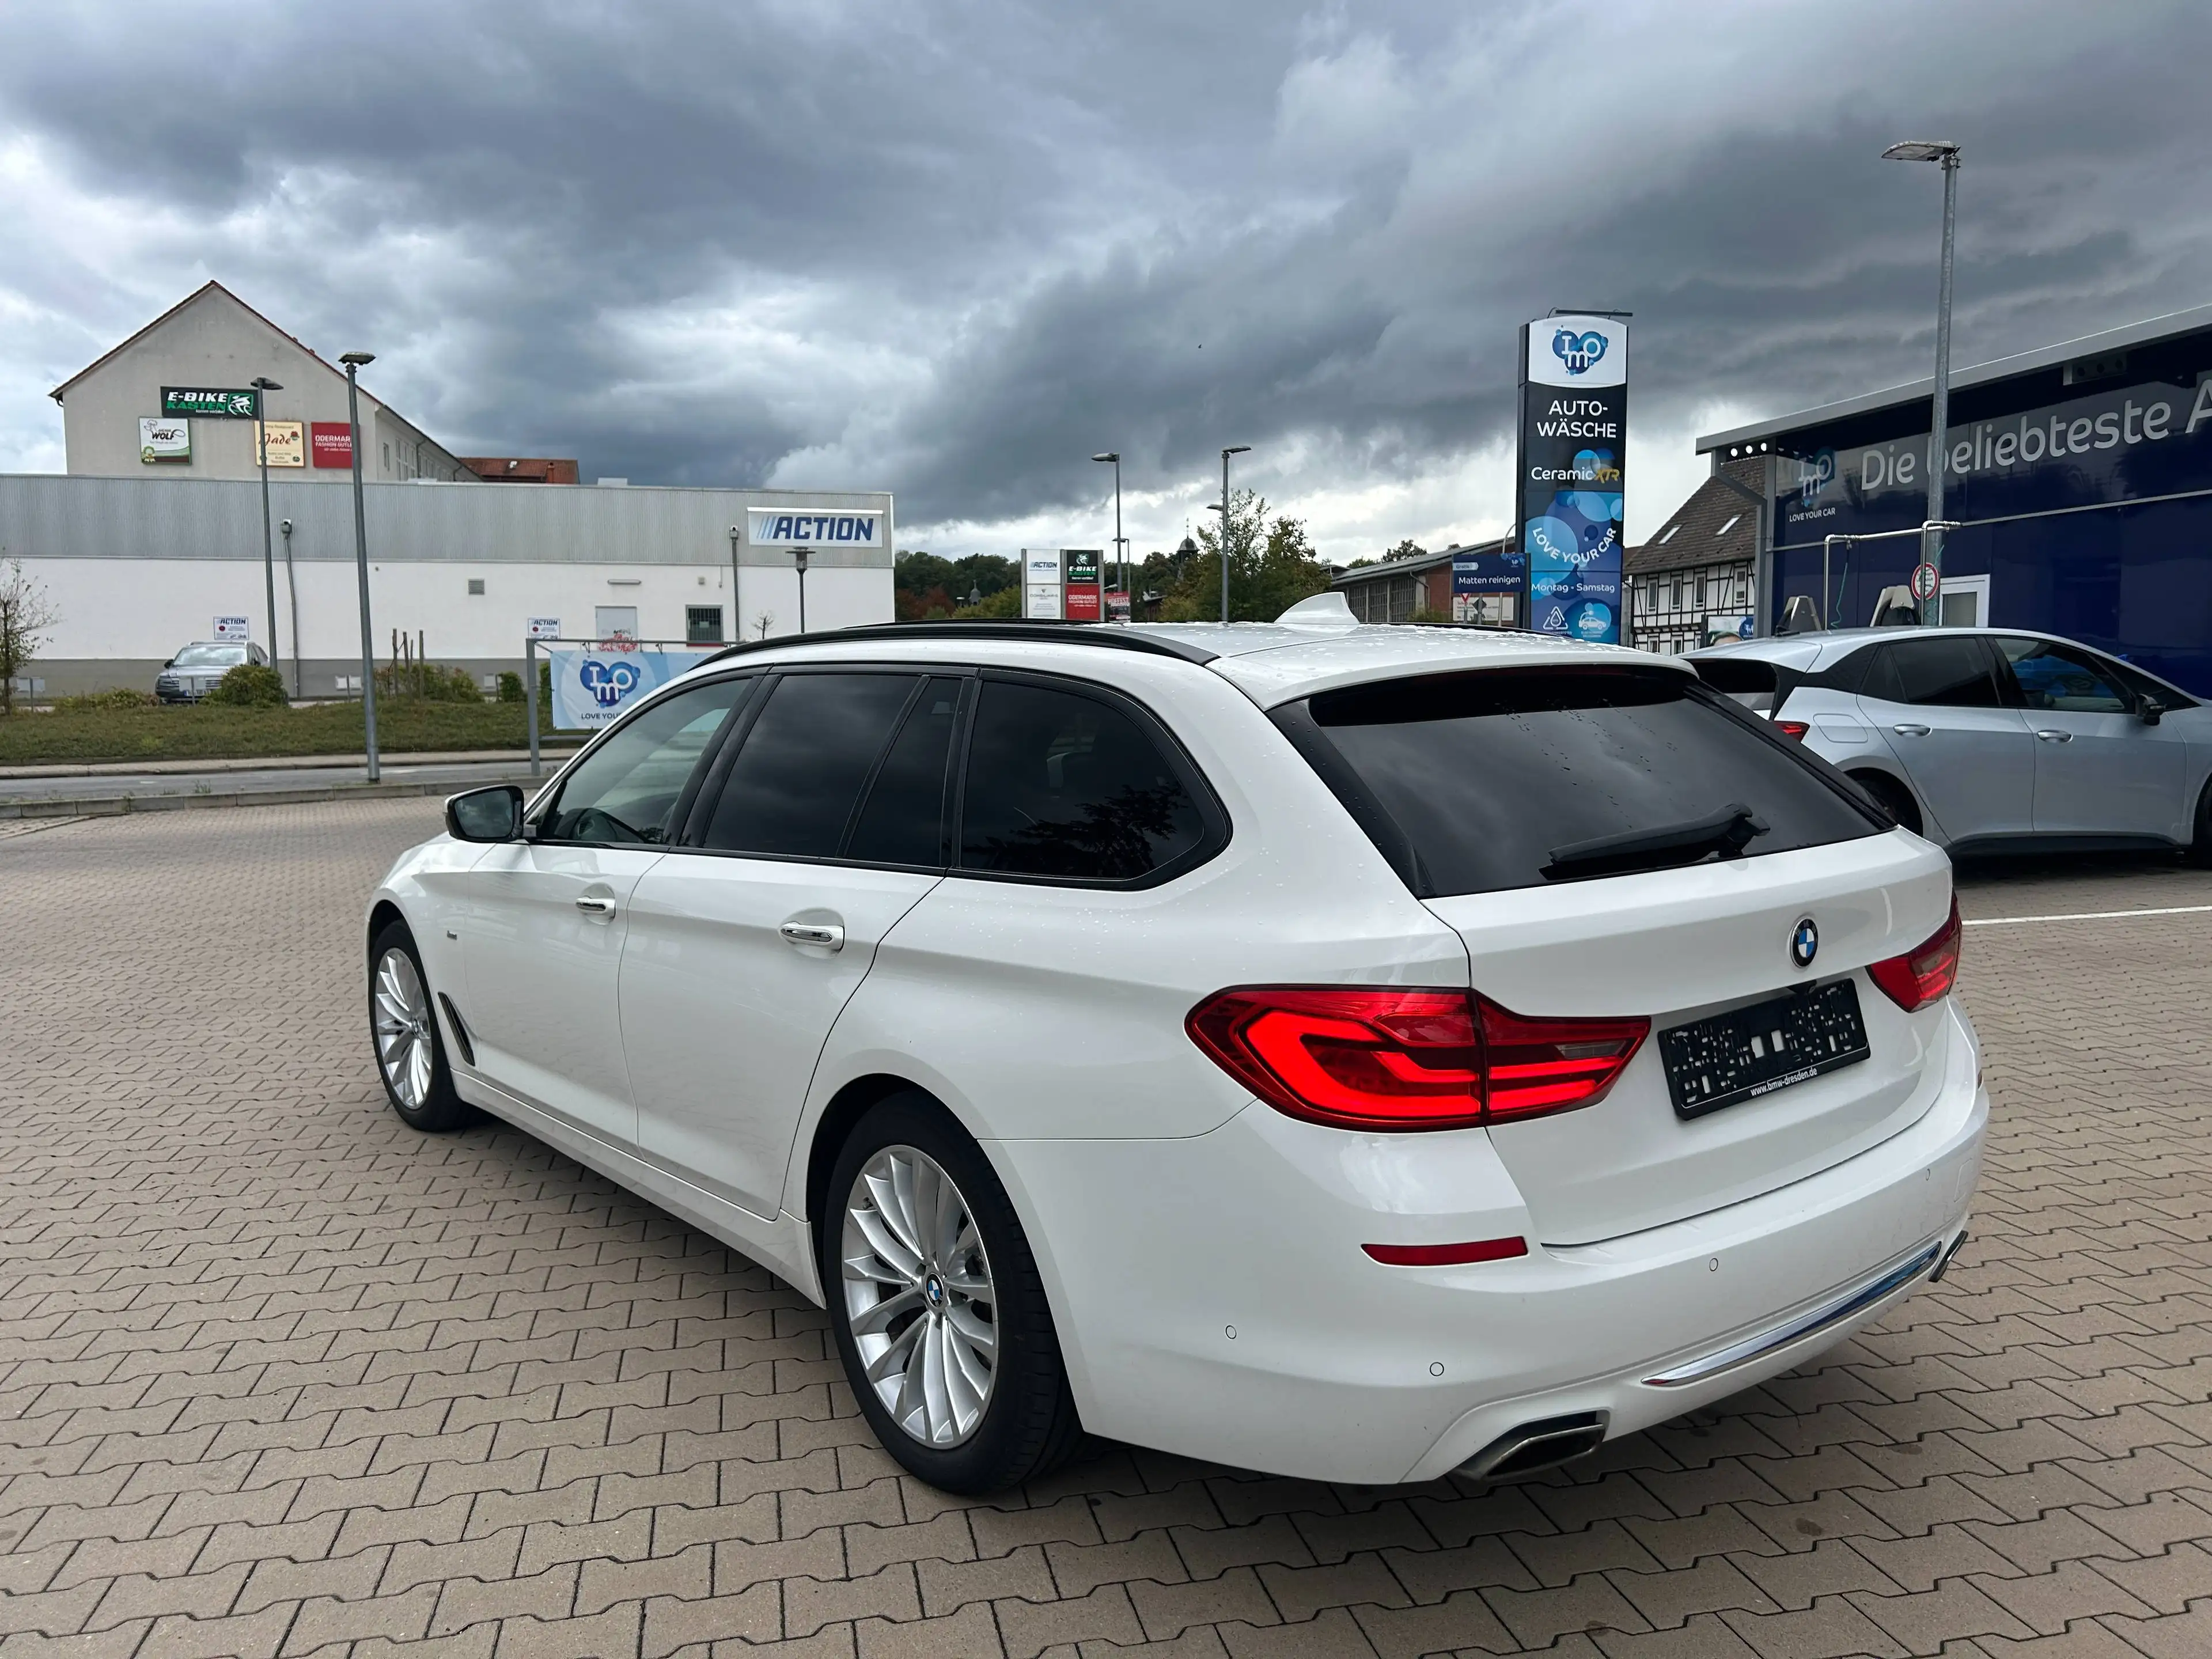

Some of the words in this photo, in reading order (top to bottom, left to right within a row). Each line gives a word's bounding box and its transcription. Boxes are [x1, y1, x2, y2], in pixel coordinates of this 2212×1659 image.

[168, 391, 228, 403] E-BIKE
[166, 401, 226, 410] KASTEN
[1548, 400, 1608, 416] AUTO-
[151, 429, 185, 440] WOLF
[1536, 418, 1616, 438] WÄSCHE
[315, 434, 351, 442] ODERMAR
[1861, 444, 1915, 490] Die
[1531, 467, 1595, 480] Ceramic
[1593, 468, 1620, 483] XTR
[1789, 512, 1805, 522] LOVE
[1805, 509, 1822, 519] YOUR
[1823, 507, 1836, 517] CAR
[772, 517, 874, 540] ACTION
[1532, 527, 1561, 560] LOVE
[1562, 548, 1600, 564] YOUR
[1598, 528, 1617, 552] CAR
[1459, 577, 1487, 585] Matten
[1488, 575, 1521, 585] reinigen
[1531, 584, 1569, 593] Montag
[1576, 583, 1615, 593] Samstag
[1751, 1067, 1817, 1096] www.bmw-dresden.de
